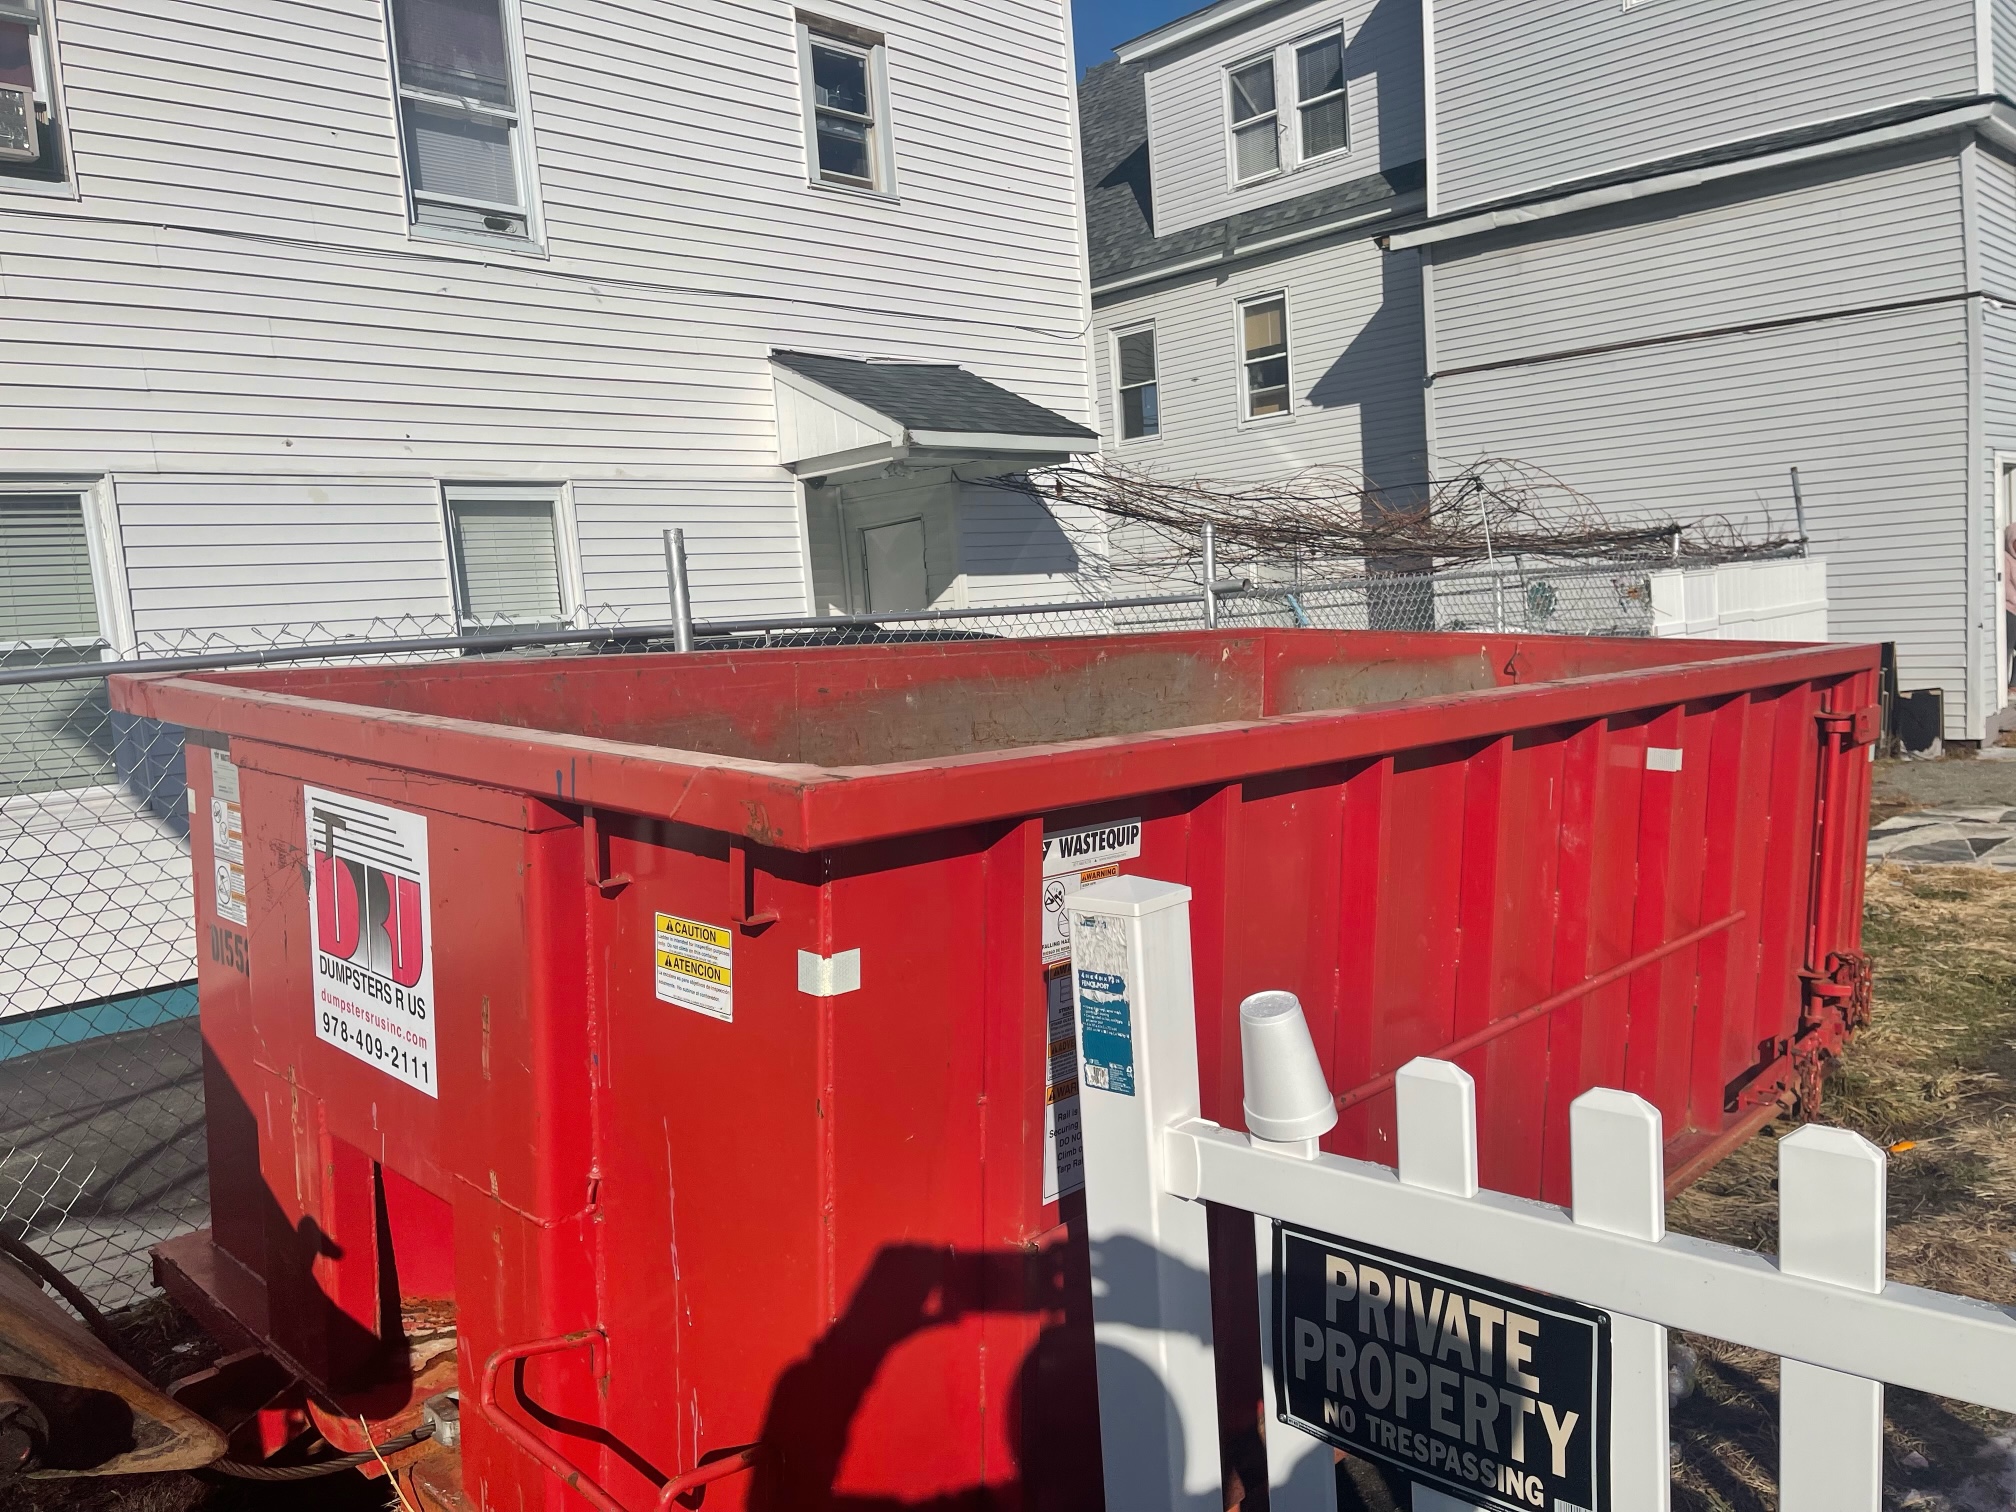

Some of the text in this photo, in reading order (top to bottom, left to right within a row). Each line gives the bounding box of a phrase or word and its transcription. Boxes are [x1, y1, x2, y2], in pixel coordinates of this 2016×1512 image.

[1059, 825, 1139, 858] WASTEQUIP
[1086, 867, 1117, 880] WARNING
[315, 850, 423, 988] DRU
[675, 922, 716, 942] CAUTION
[673, 957, 721, 982] ATENCION
[320, 955, 426, 1019] DUMPSTERS R US
[321, 988, 427, 1050] dumpstersrusinc.com
[323, 1012, 428, 1083] 978-409-2111
[1049, 1121, 1079, 1138] Securing
[1058, 1110, 1070, 1122] Rail
[1058, 1147, 1076, 1161] Climb
[1060, 1136, 1070, 1148] DO
[1057, 1163, 1071, 1175] Tarp
[1325, 1253, 1540, 1394] PRIVATE
[1294, 1316, 1579, 1478] PROPERTY
[1324, 1397, 1356, 1433] NO
[1365, 1415, 1544, 1508] TRESPASSING
